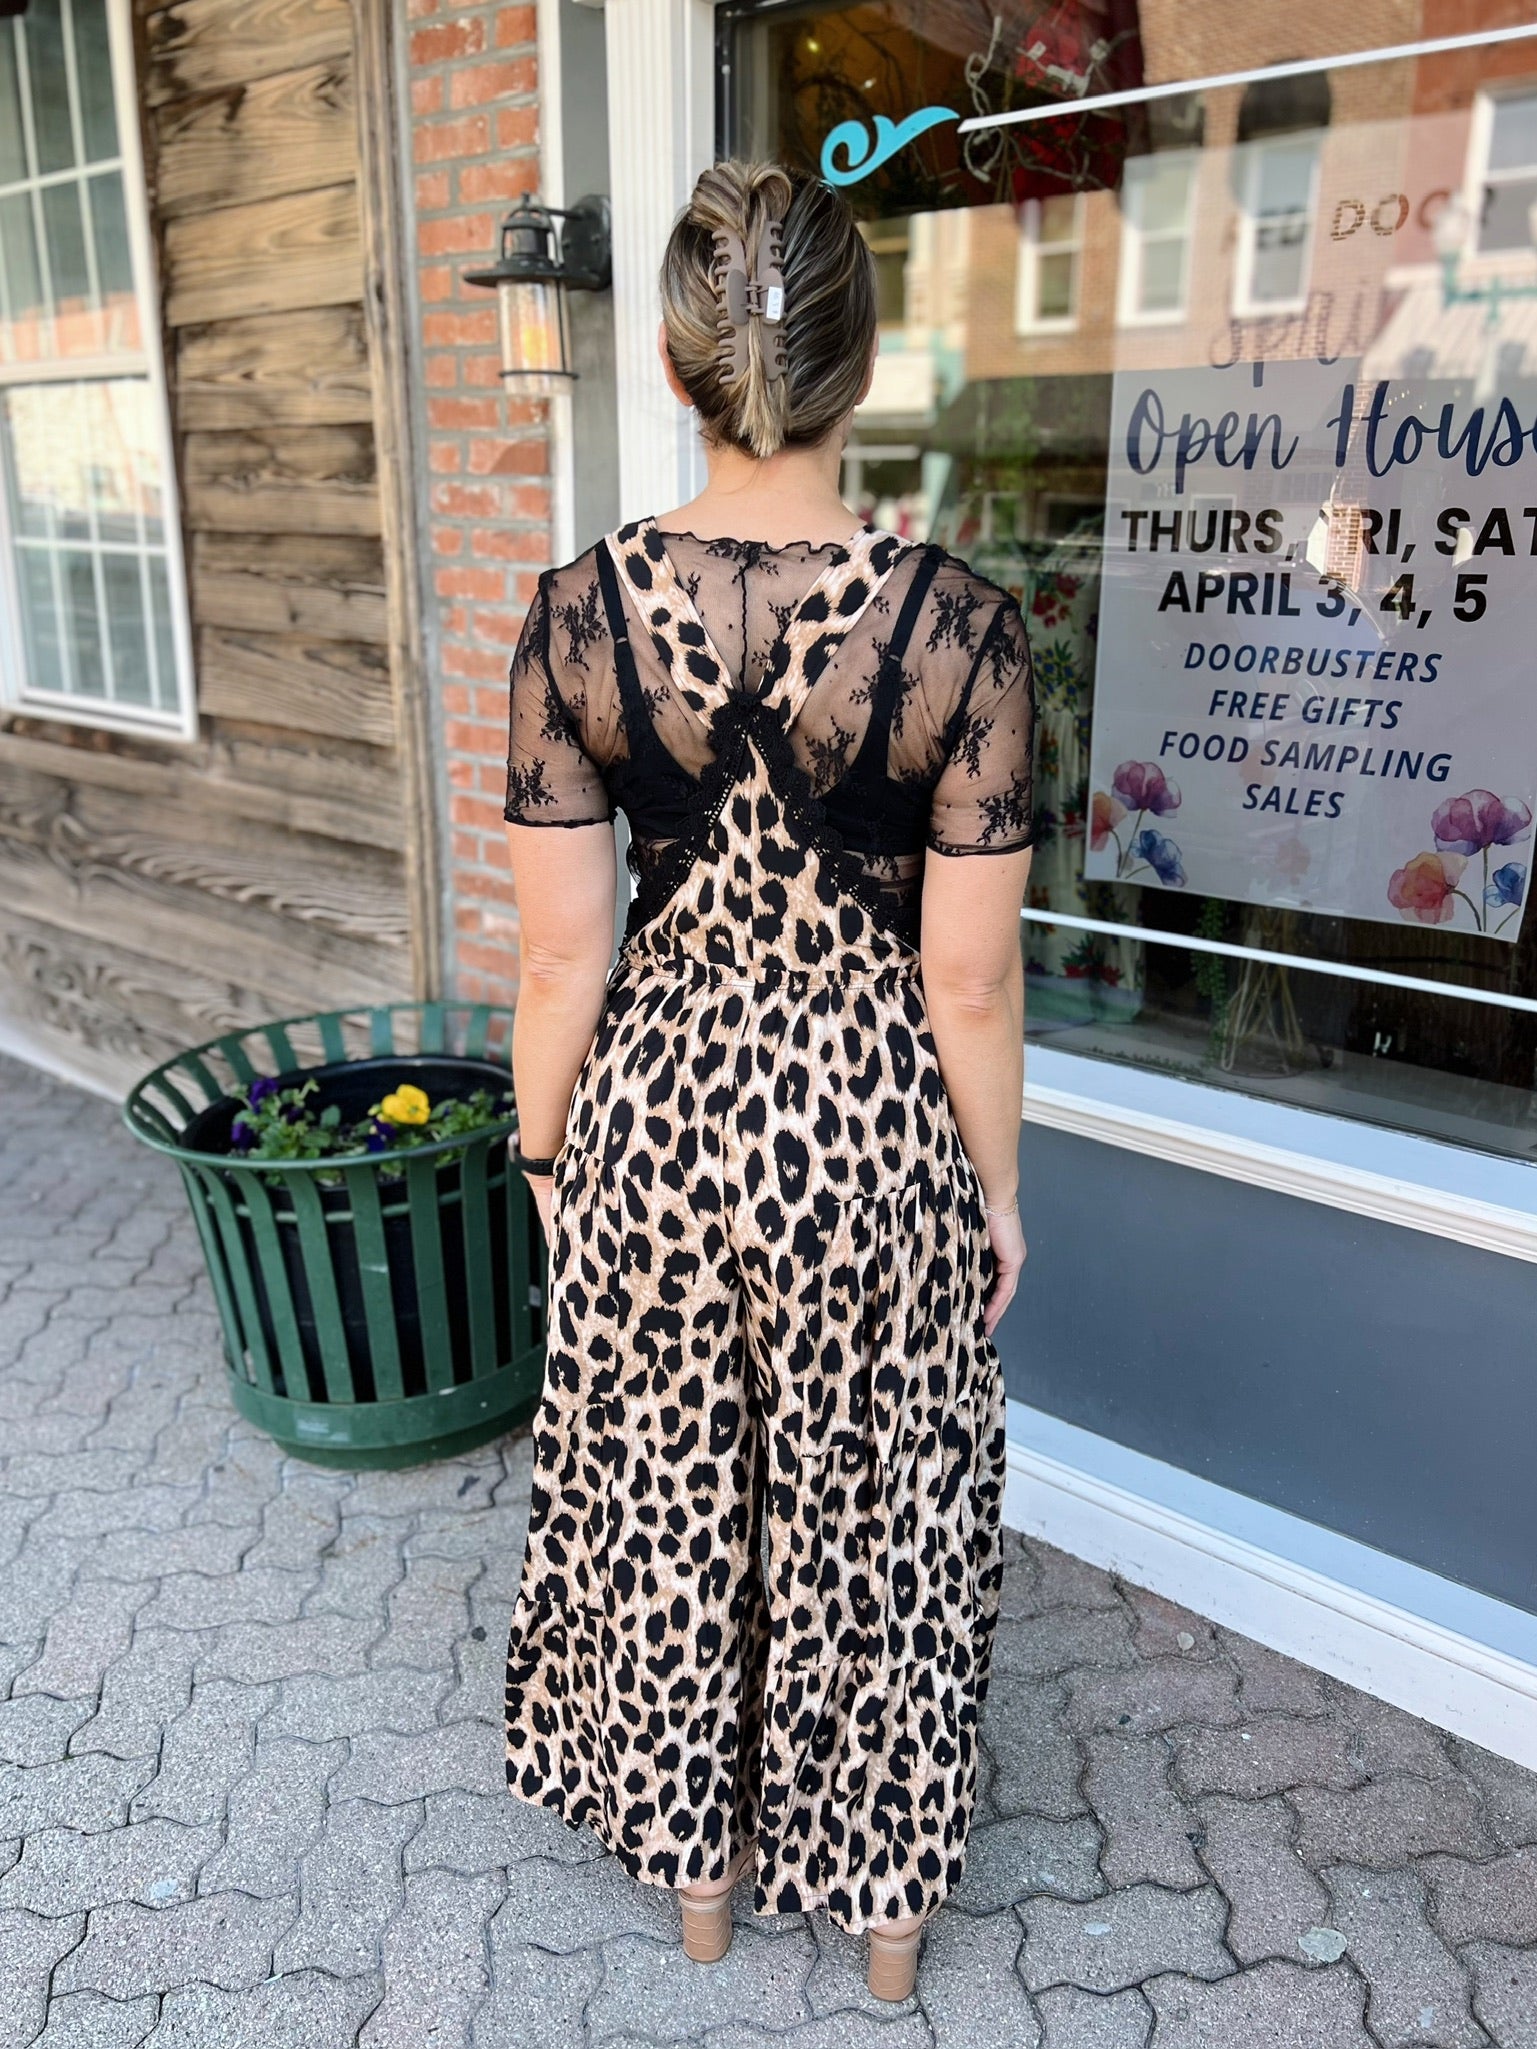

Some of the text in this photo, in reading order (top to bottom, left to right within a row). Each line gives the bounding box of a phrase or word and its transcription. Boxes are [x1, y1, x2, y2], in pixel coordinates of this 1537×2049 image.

[1127, 381, 1537, 494] Open Hous
[1121, 509, 1299, 562] THURS,
[1319, 508, 1416, 563] RI,
[1157, 570, 1488, 629] APRIL 3, 4, 5
[1184, 642, 1443, 683] DOORBUSTERS
[1208, 690, 1403, 730] FREE GIFTS
[1159, 731, 1453, 783] FOOD SAMPLING
[1242, 783, 1344, 819] SALES
